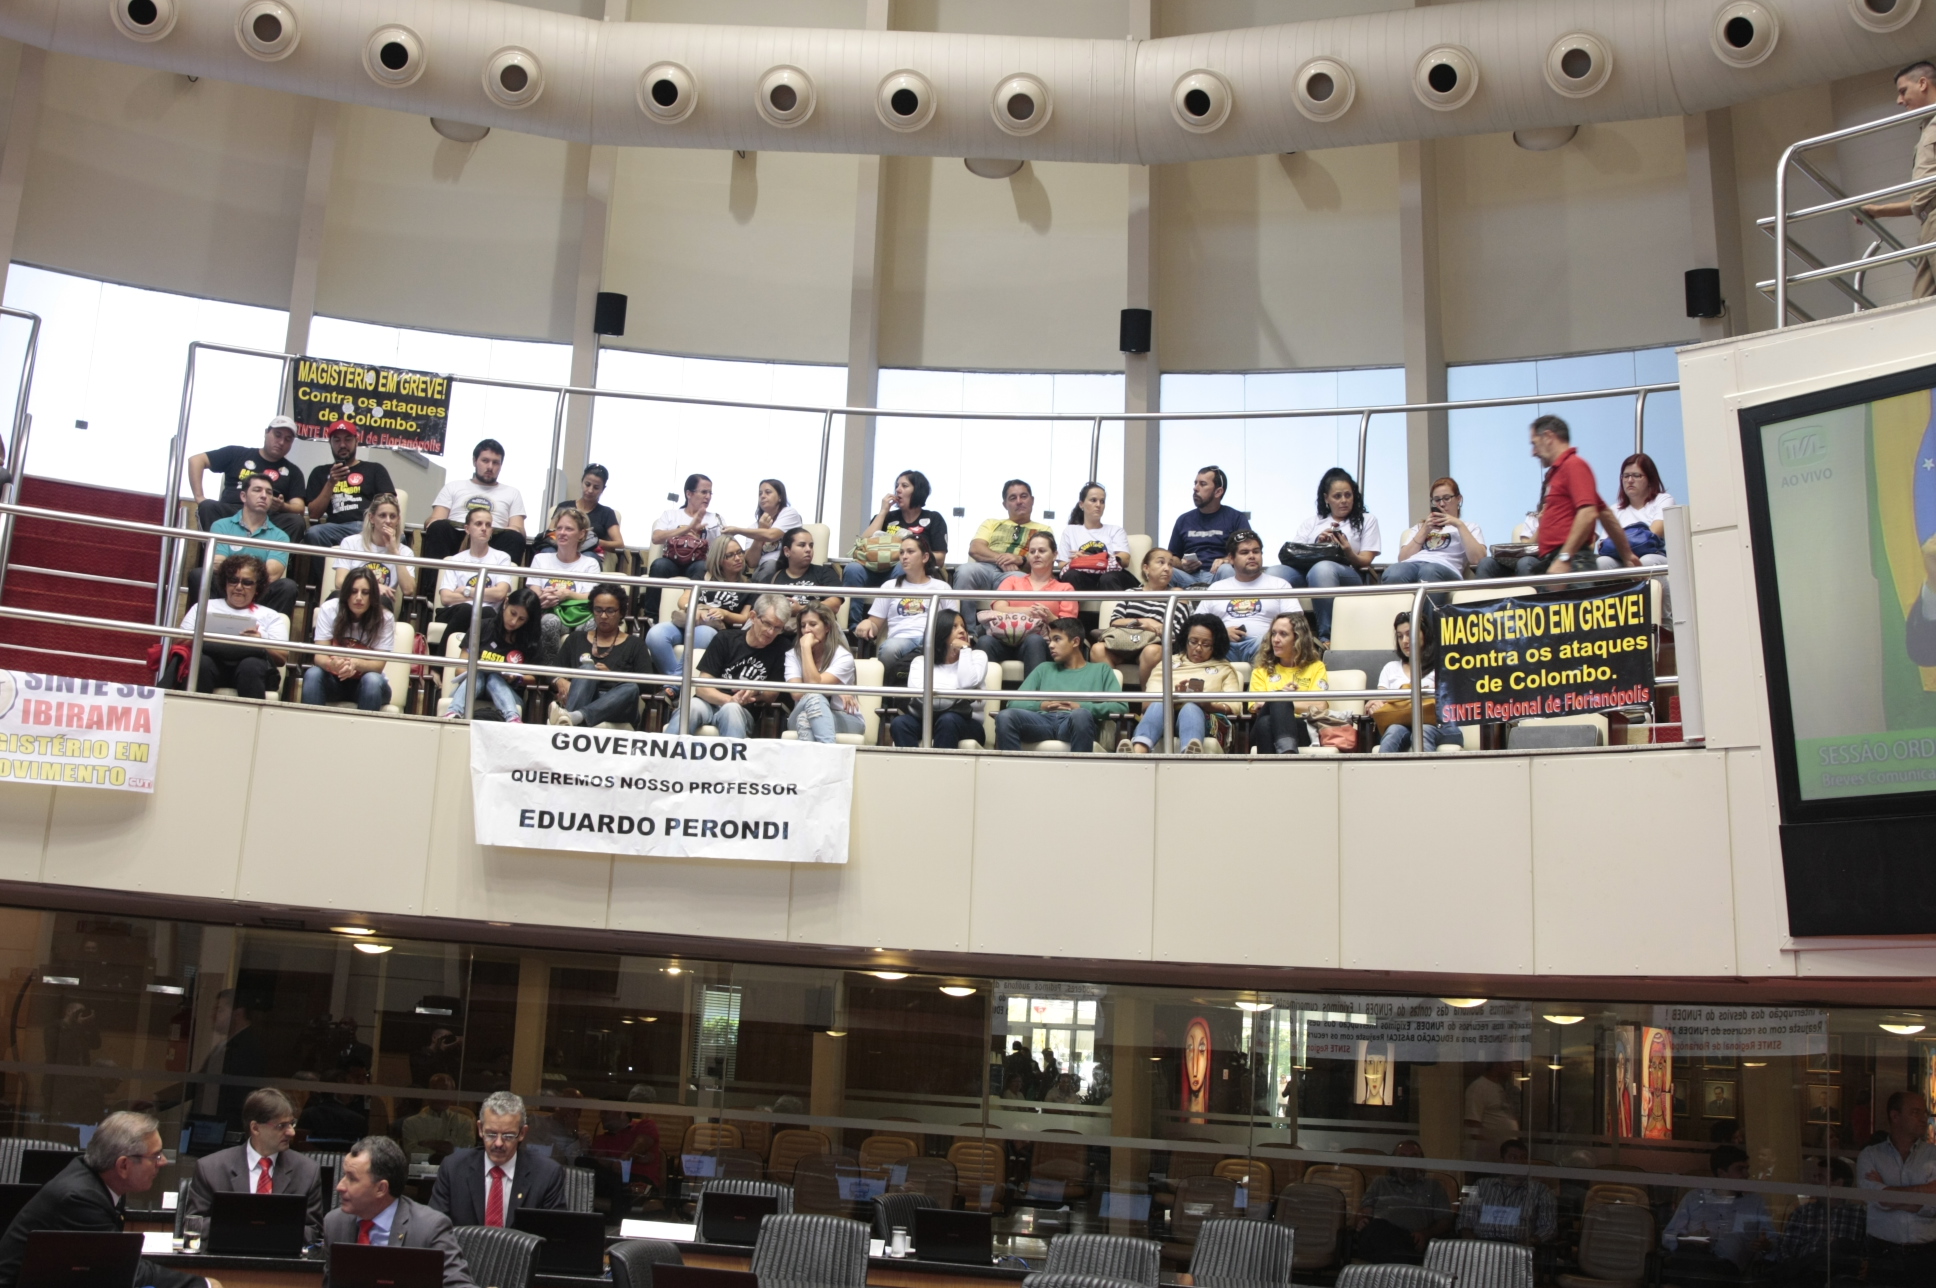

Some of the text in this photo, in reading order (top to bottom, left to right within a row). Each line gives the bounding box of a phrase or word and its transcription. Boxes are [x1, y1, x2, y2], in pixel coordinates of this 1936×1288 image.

[298, 360, 447, 400] MAGISTÉRIO EM GREVE!
[298, 387, 446, 418] Contra os ataques
[318, 408, 421, 432] de Colombo.
[366, 431, 378, 445] de
[380, 434, 441, 453] Florianópolis
[1781, 467, 1833, 488] AO VIVO
[1440, 594, 1645, 646] MAGISTÉRIO EM GREVE!
[481, 650, 505, 662] BASTA
[1444, 635, 1648, 671] Contra os ataques
[24, 672, 108, 697] SINTE
[1475, 664, 1618, 694] de Colombo.
[21, 698, 152, 734] IBIRAMA
[1442, 684, 1650, 723] SINTE Regional de Florianópolis
[114, 741, 150, 763] EM
[551, 731, 747, 762] GOVERNADOR
[1819, 740, 1888, 766] SESSÃO
[129, 777, 151, 788] CUT
[511, 768, 799, 796] QUEREMOS NOSSO PROFESSOR
[1822, 772, 1865, 788] Breves
[519, 808, 789, 840] EDUARDO PERONDI
